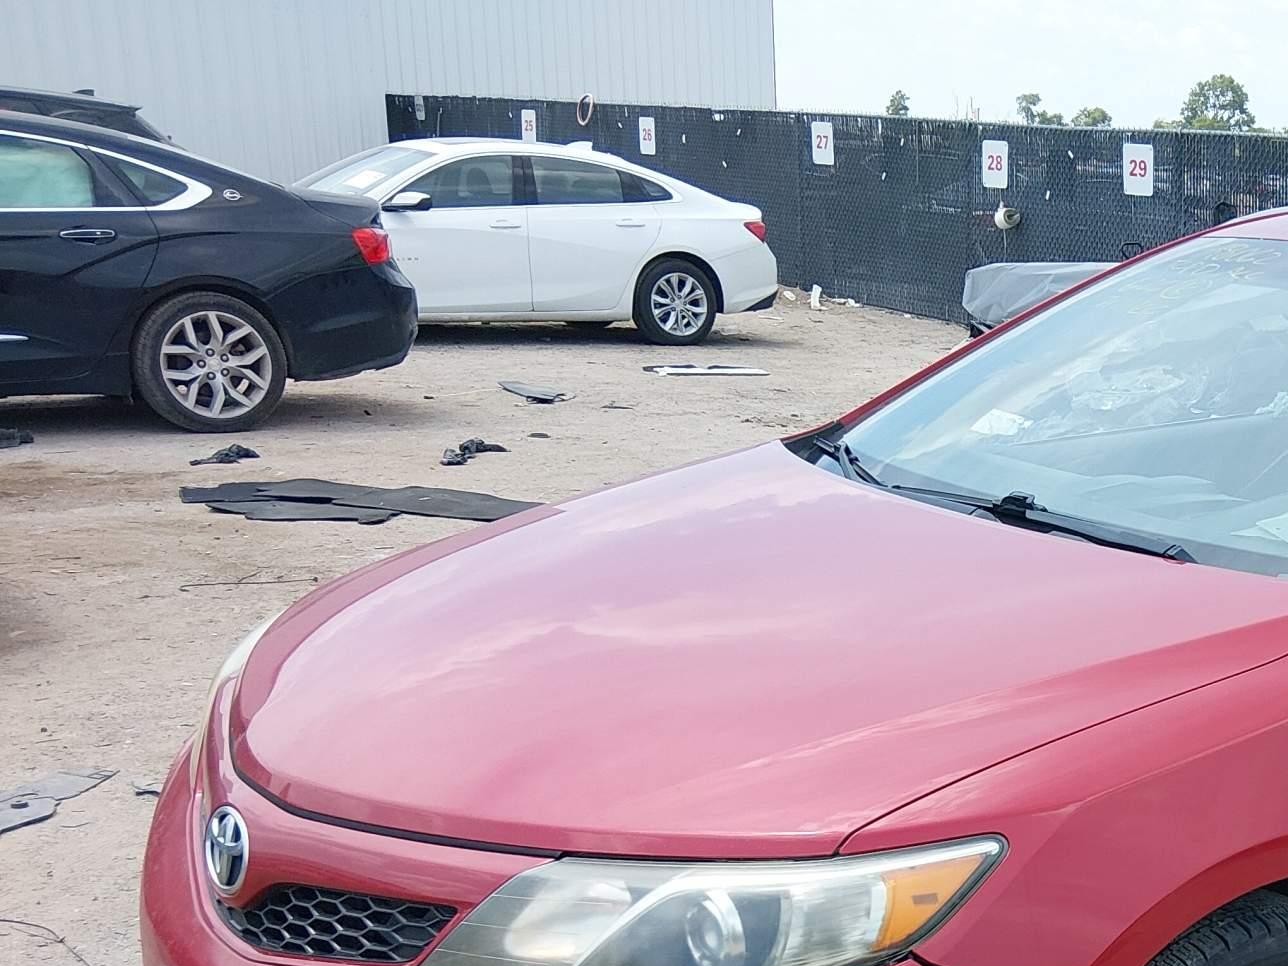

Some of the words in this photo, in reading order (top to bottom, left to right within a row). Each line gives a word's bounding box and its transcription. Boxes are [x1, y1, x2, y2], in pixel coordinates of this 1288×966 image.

[524, 119, 534, 132] 25
[642, 128, 653, 142] 26
[816, 134, 829, 150] 27
[987, 154, 1003, 171] 28
[1129, 159, 1148, 177] 29
